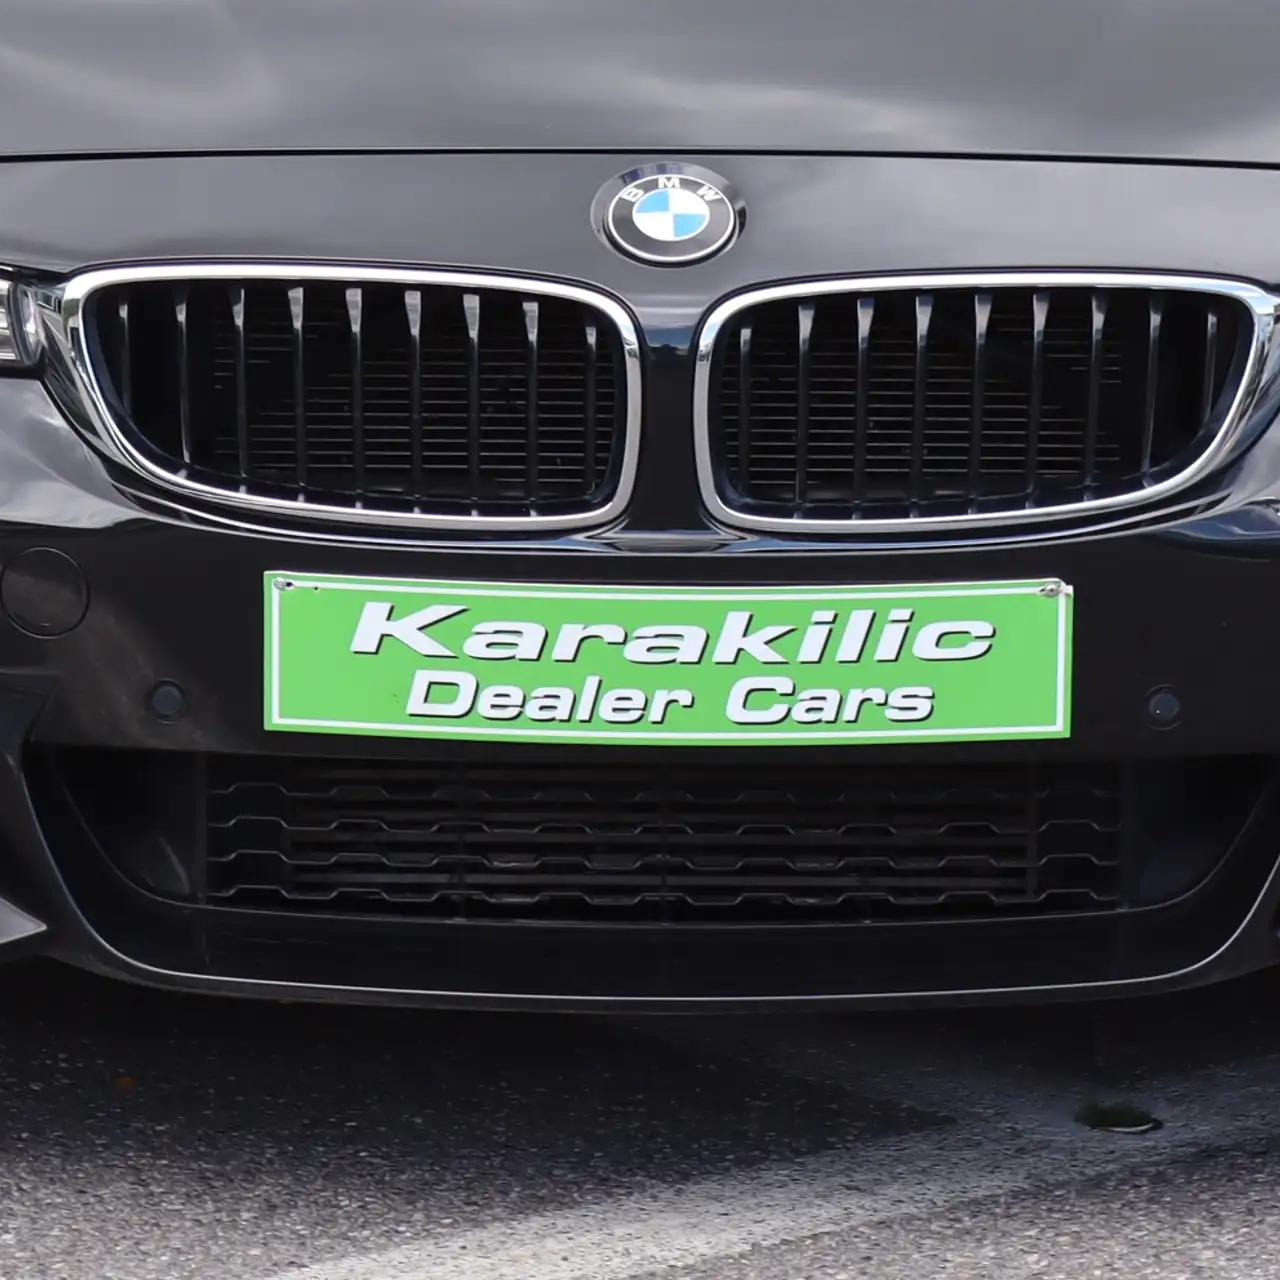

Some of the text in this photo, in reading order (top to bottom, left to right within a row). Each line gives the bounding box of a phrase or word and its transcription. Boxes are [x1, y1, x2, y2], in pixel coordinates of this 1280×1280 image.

[619, 176, 723, 202] BMW
[349, 601, 996, 665] Karakilic
[405, 669, 935, 725] Dealer Cars
